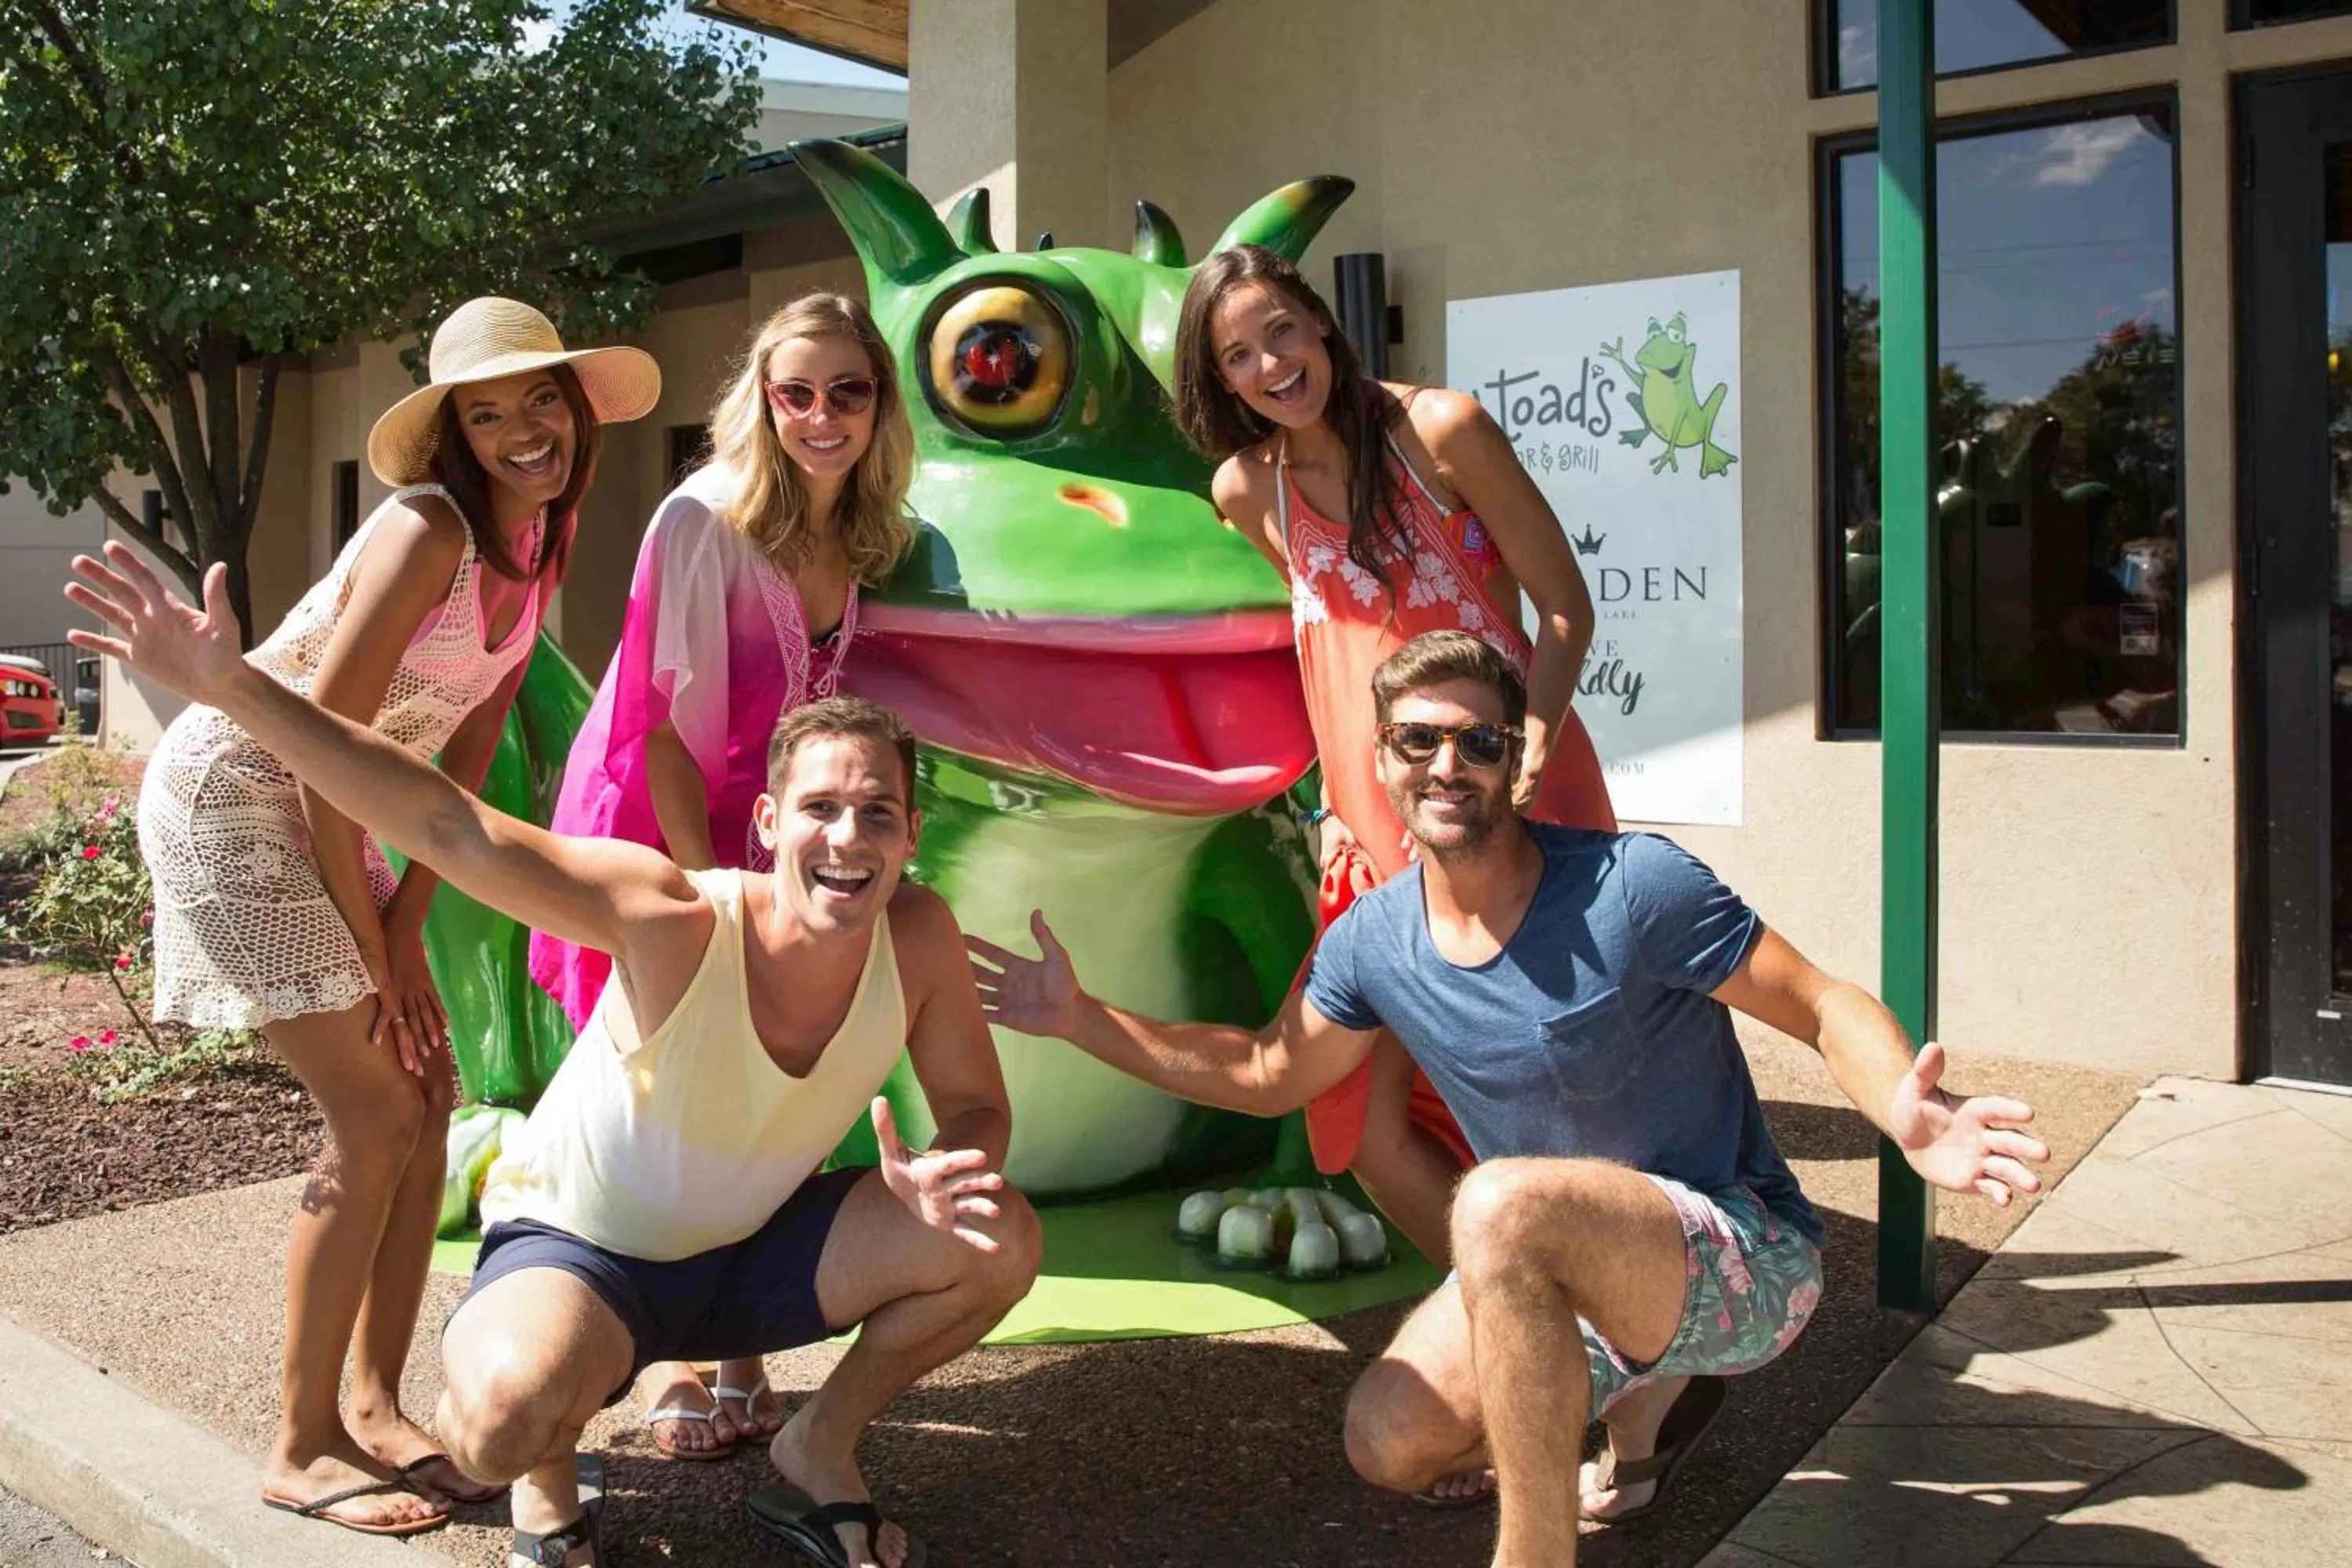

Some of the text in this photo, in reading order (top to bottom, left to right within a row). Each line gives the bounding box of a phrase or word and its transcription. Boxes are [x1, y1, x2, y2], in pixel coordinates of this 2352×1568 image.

[1541, 441, 1553, 475] &
[1599, 566, 1707, 602] DEN
[1604, 610, 1640, 620] LAKE
[1591, 639, 1619, 656] VE
[1577, 658, 1646, 716] ldly
[1609, 760, 1644, 776] COM
